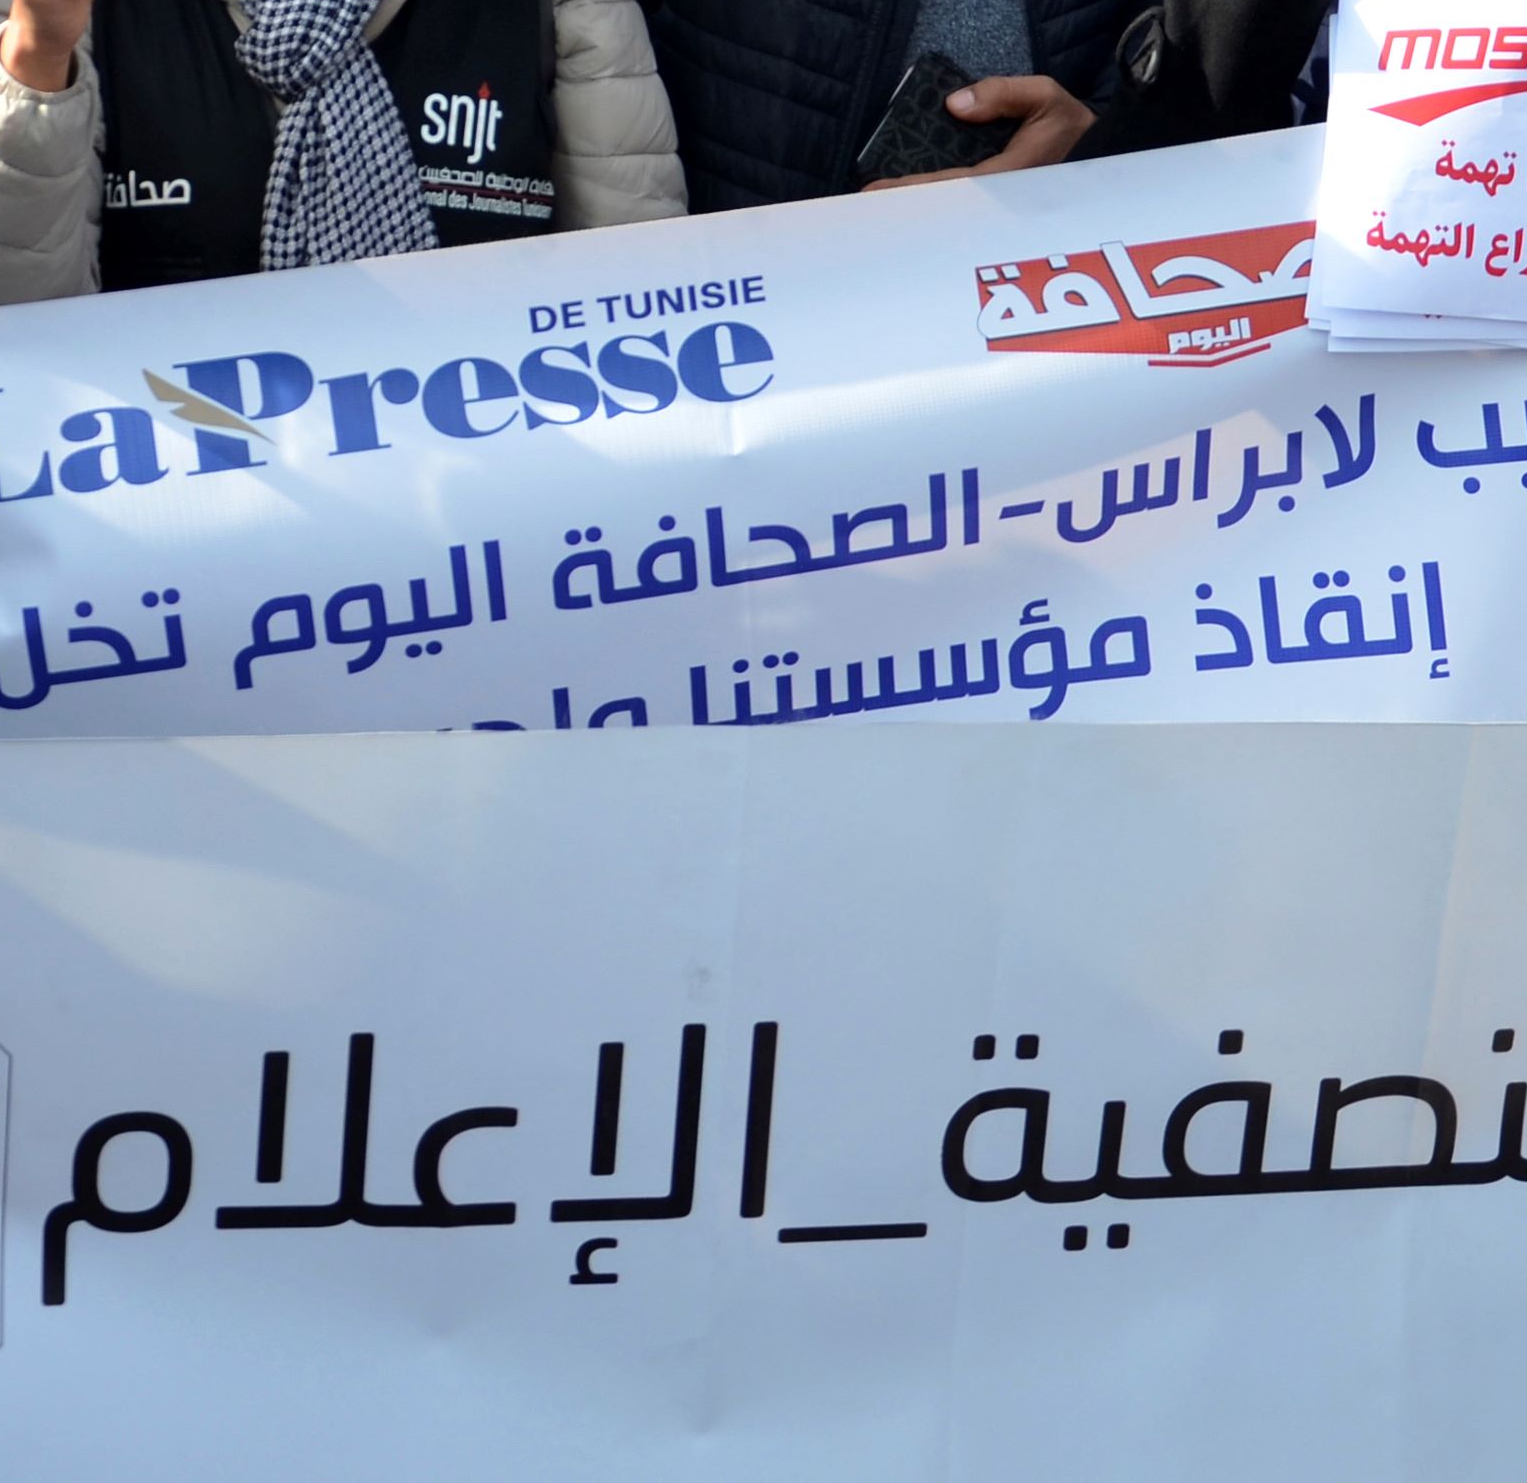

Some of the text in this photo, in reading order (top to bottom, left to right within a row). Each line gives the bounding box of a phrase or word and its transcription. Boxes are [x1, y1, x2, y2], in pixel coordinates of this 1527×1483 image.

[420, 82, 504, 165] snjt
[1434, 138, 1517, 198] تهمة
[1364, 210, 1475, 269] التهمة
[528, 275, 767, 334] DE TUNISIE
[1167, 318, 1252, 354] اليوم
[231, 540, 508, 692] اليوم
[1192, 560, 1452, 683] إنقاذ
